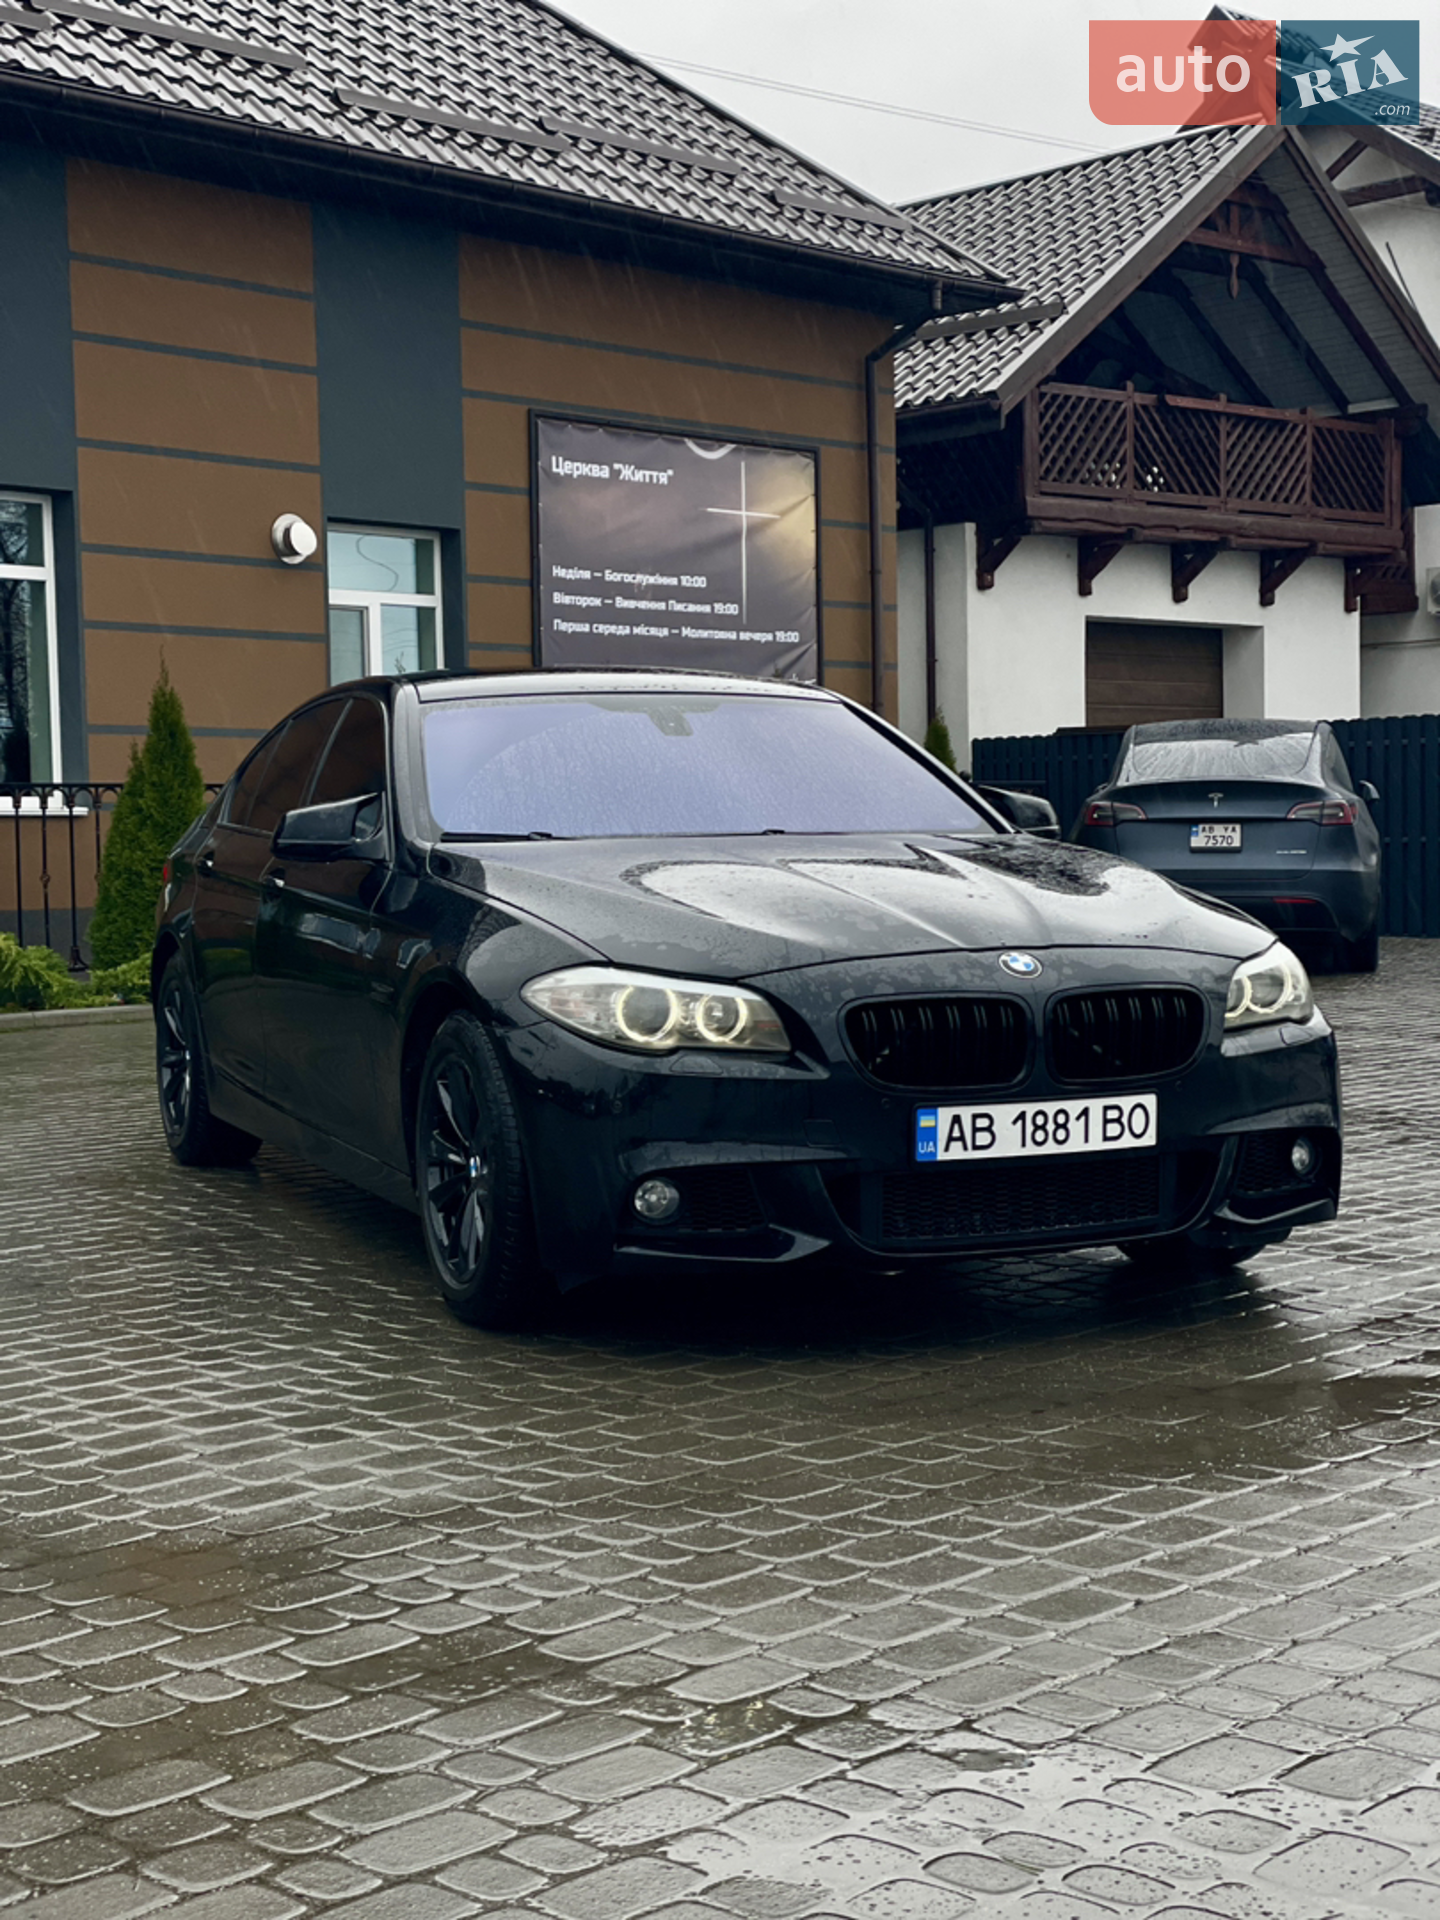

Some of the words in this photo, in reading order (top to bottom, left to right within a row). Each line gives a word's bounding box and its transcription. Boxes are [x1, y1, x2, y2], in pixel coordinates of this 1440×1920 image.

[551, 455, 610, 478] Церква
[613, 462, 674, 485] "Життя"
[552, 565, 591, 580] Неділя
[604, 569, 679, 586] Богослужіння
[680, 575, 707, 588] 10:00
[553, 592, 602, 608] Вівторок
[615, 596, 666, 611] Вивчення
[668, 600, 711, 613] Писання
[713, 602, 739, 615] 19:00
[553, 618, 590, 634] Перша
[592, 623, 631, 636] середа
[633, 624, 669, 637] місяця
[682, 626, 737, 640] Молитовна
[739, 631, 774, 643] вечеря
[774, 631, 800, 643] 19:00
[1204, 835, 1234, 846] 7570
[943, 1112, 997, 1152] AB
[1011, 1106, 1090, 1149] 1881
[1102, 1102, 1150, 1143] BO
[918, 1141, 936, 1153] UA
